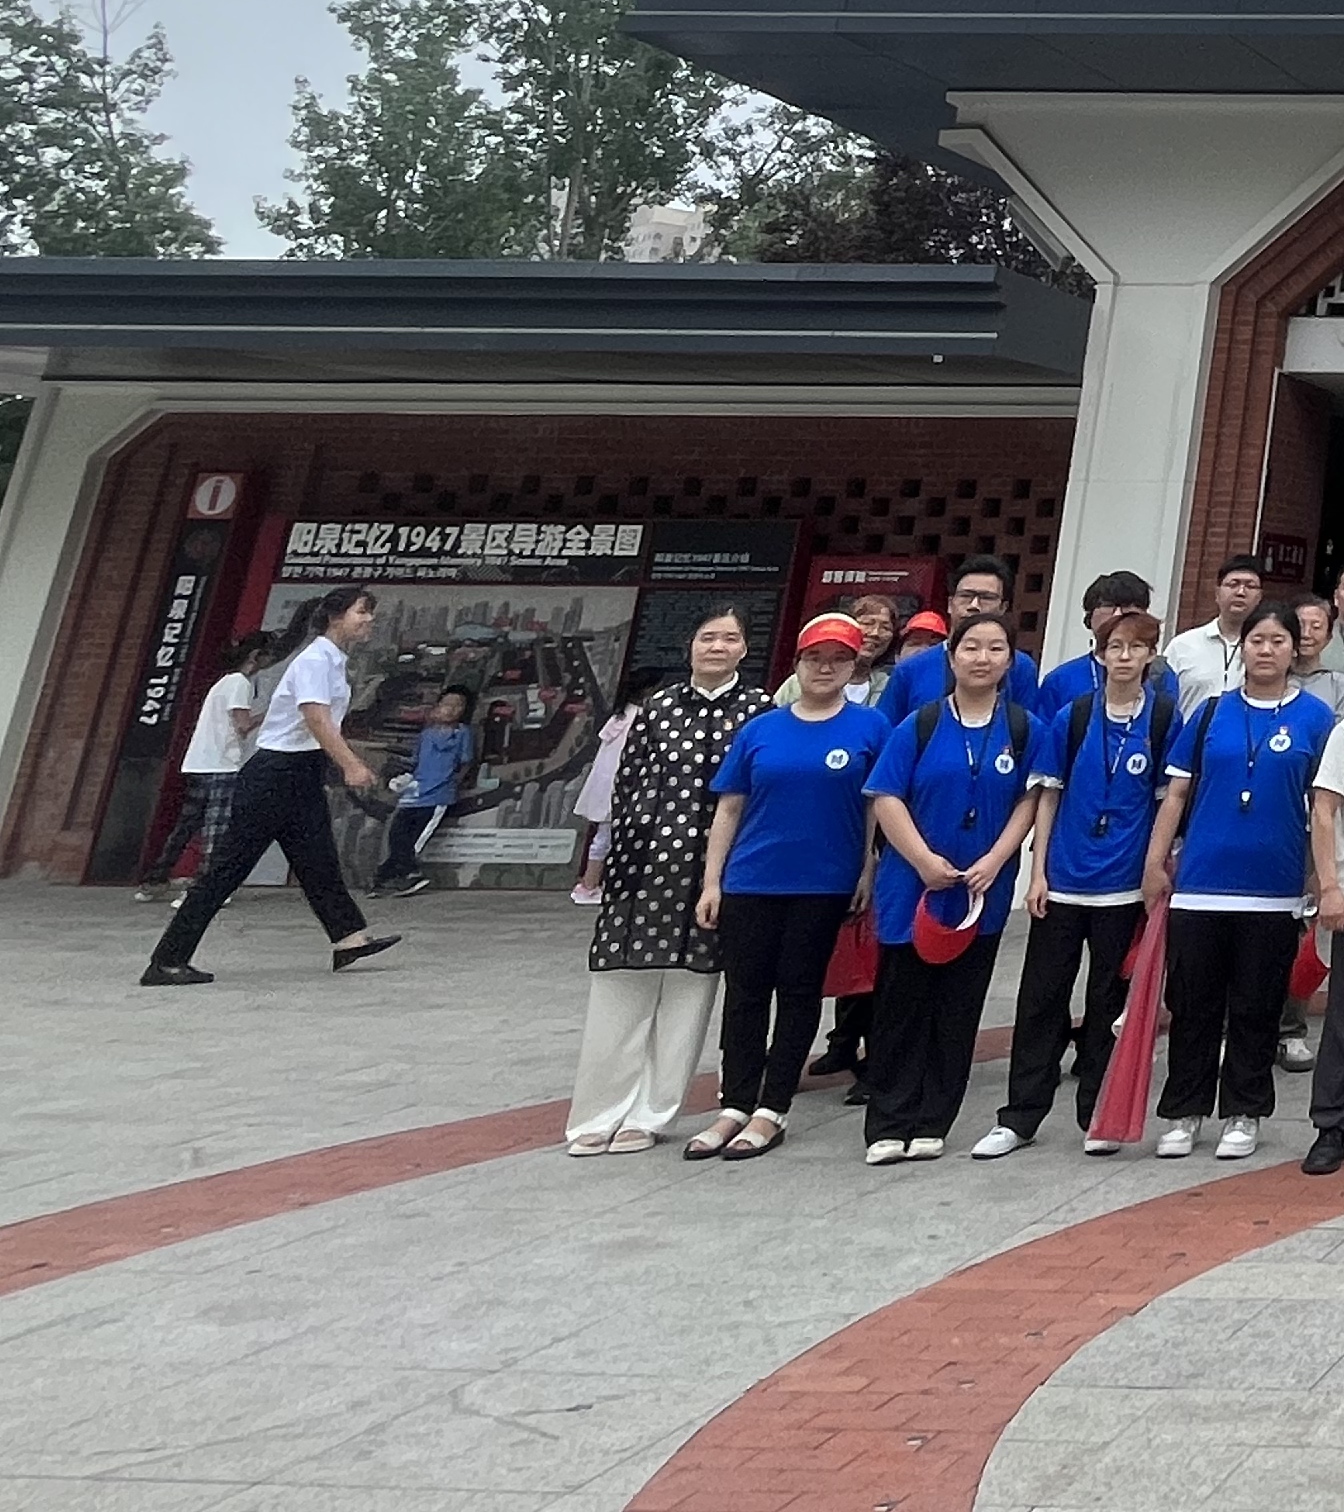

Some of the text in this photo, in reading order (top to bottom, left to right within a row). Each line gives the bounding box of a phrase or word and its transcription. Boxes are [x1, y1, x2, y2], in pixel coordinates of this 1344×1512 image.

[286, 522, 644, 556] 阳泉记忆1947景区导游全景图
